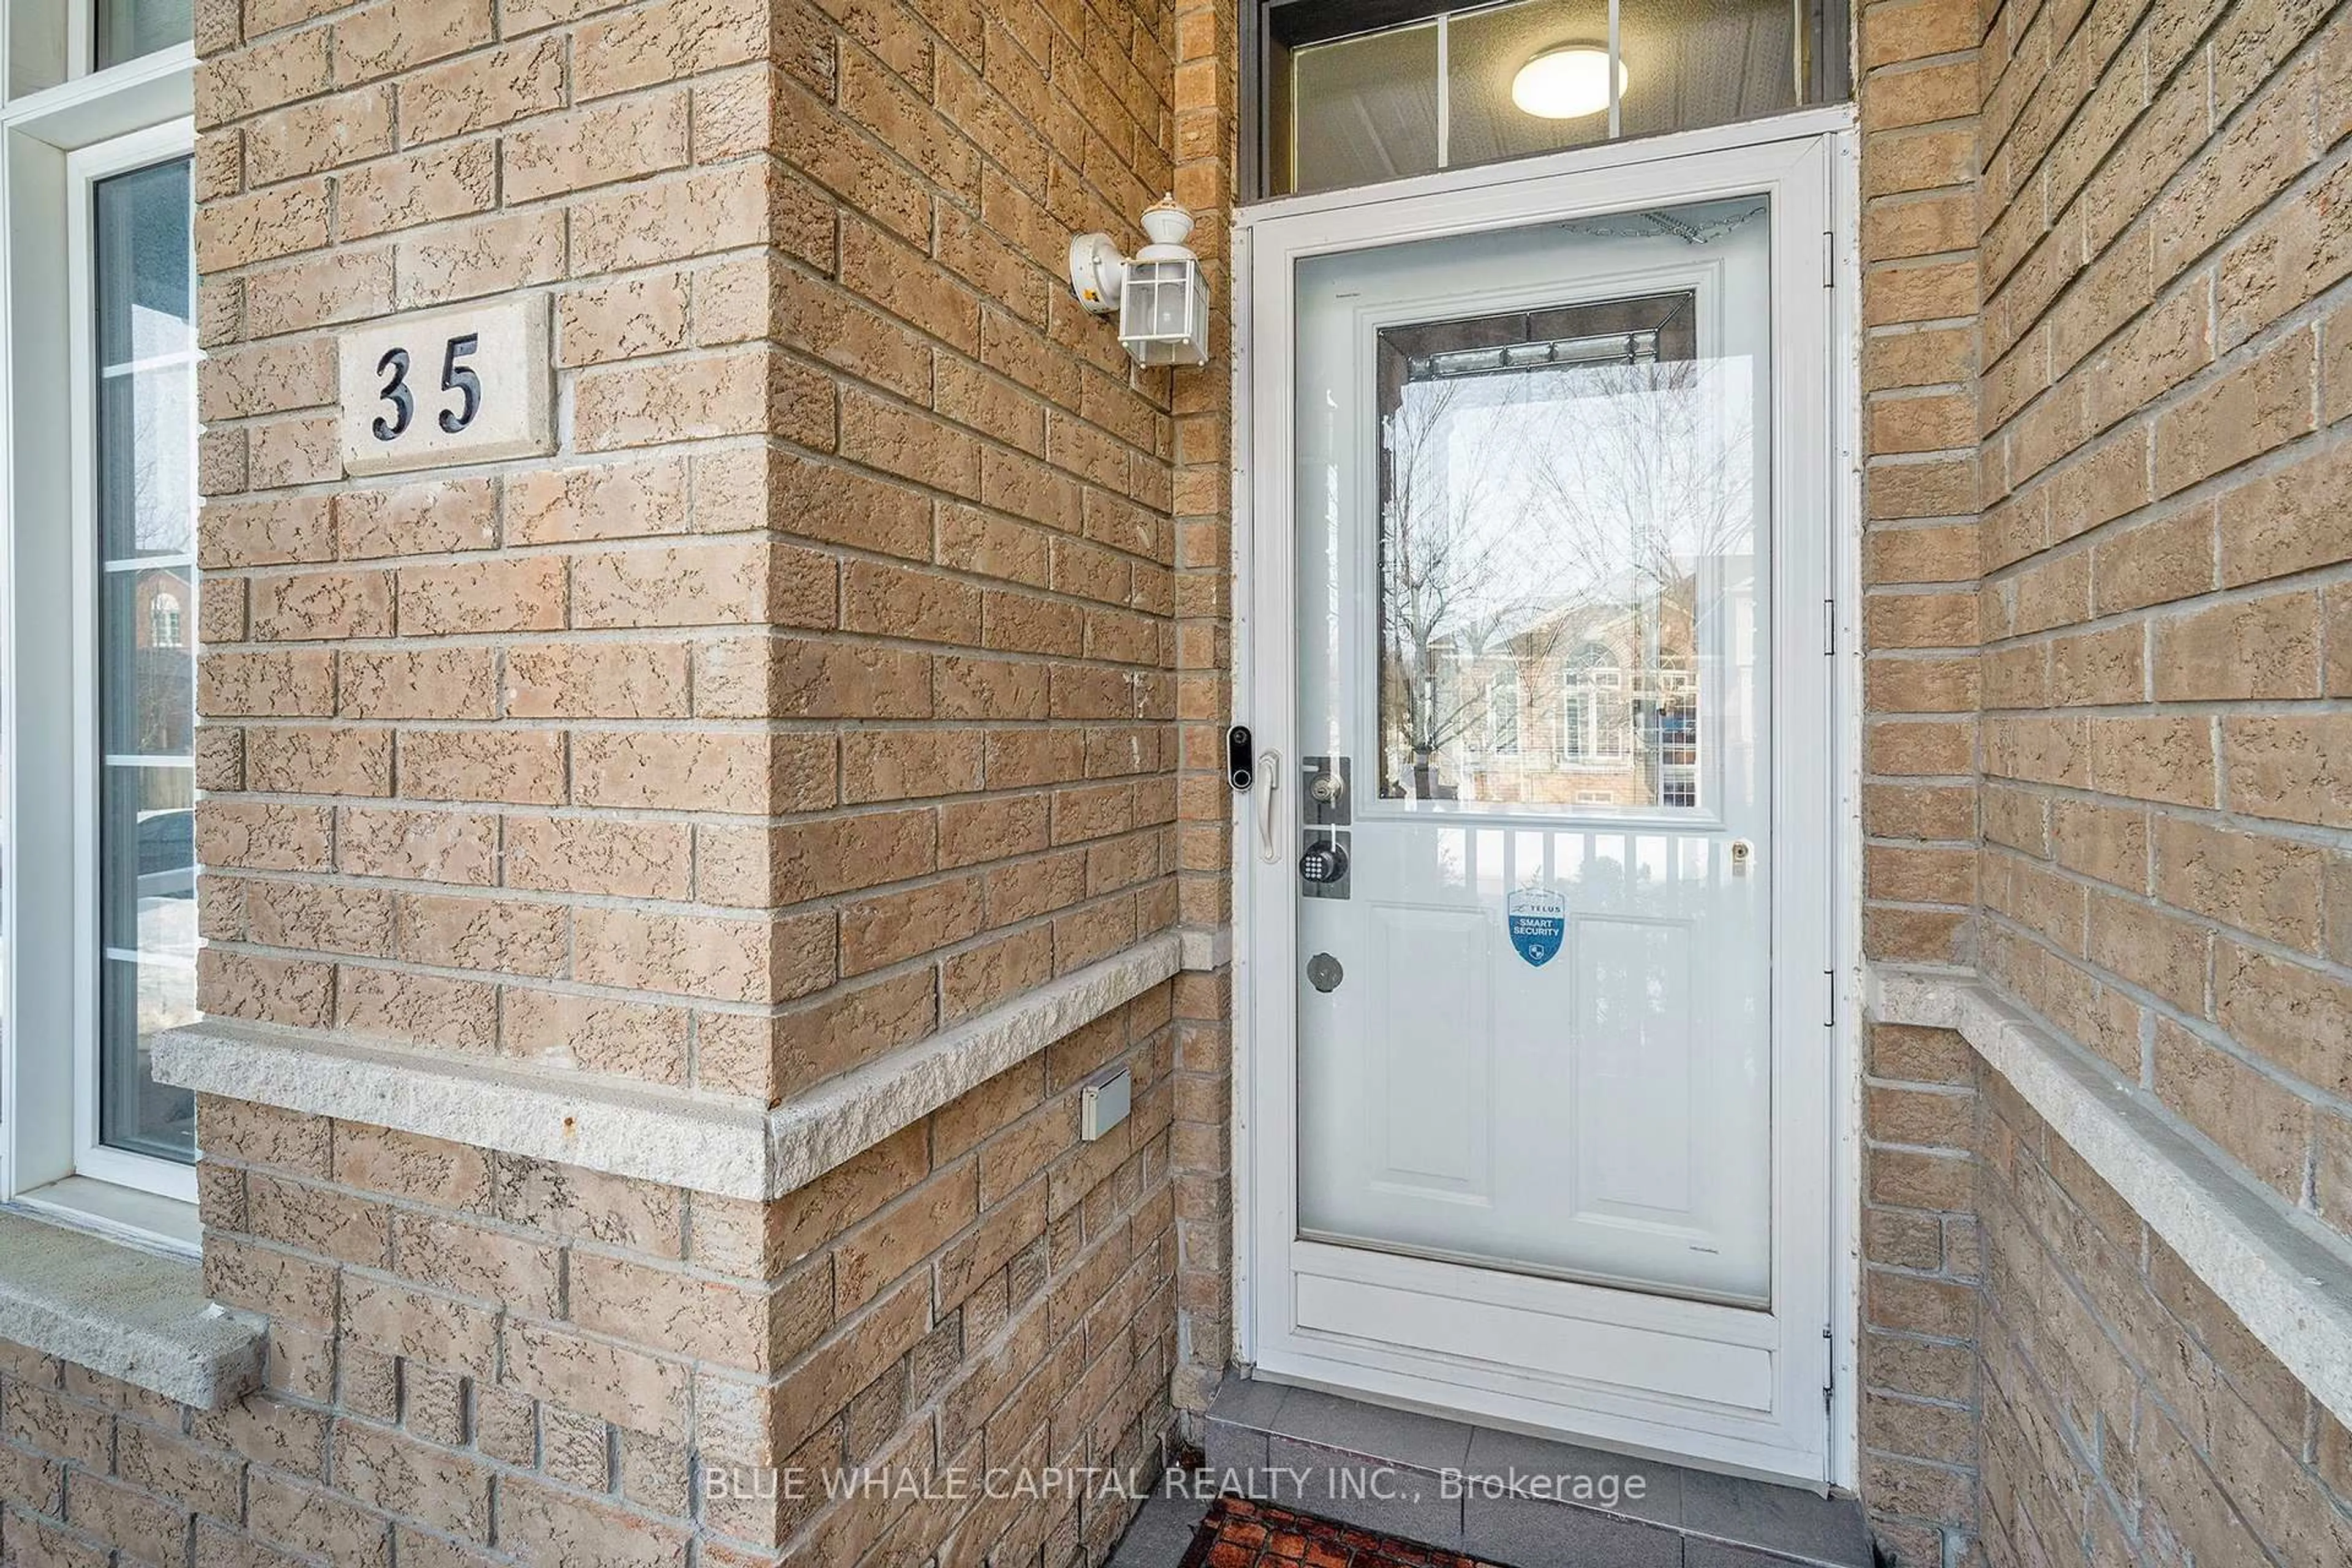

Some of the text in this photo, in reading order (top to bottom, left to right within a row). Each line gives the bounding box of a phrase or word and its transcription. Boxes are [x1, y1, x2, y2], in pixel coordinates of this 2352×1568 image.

[372, 332, 481, 441] 35
[1520, 919, 1553, 927] SMART
[1513, 926, 1559, 937] SECURITY
